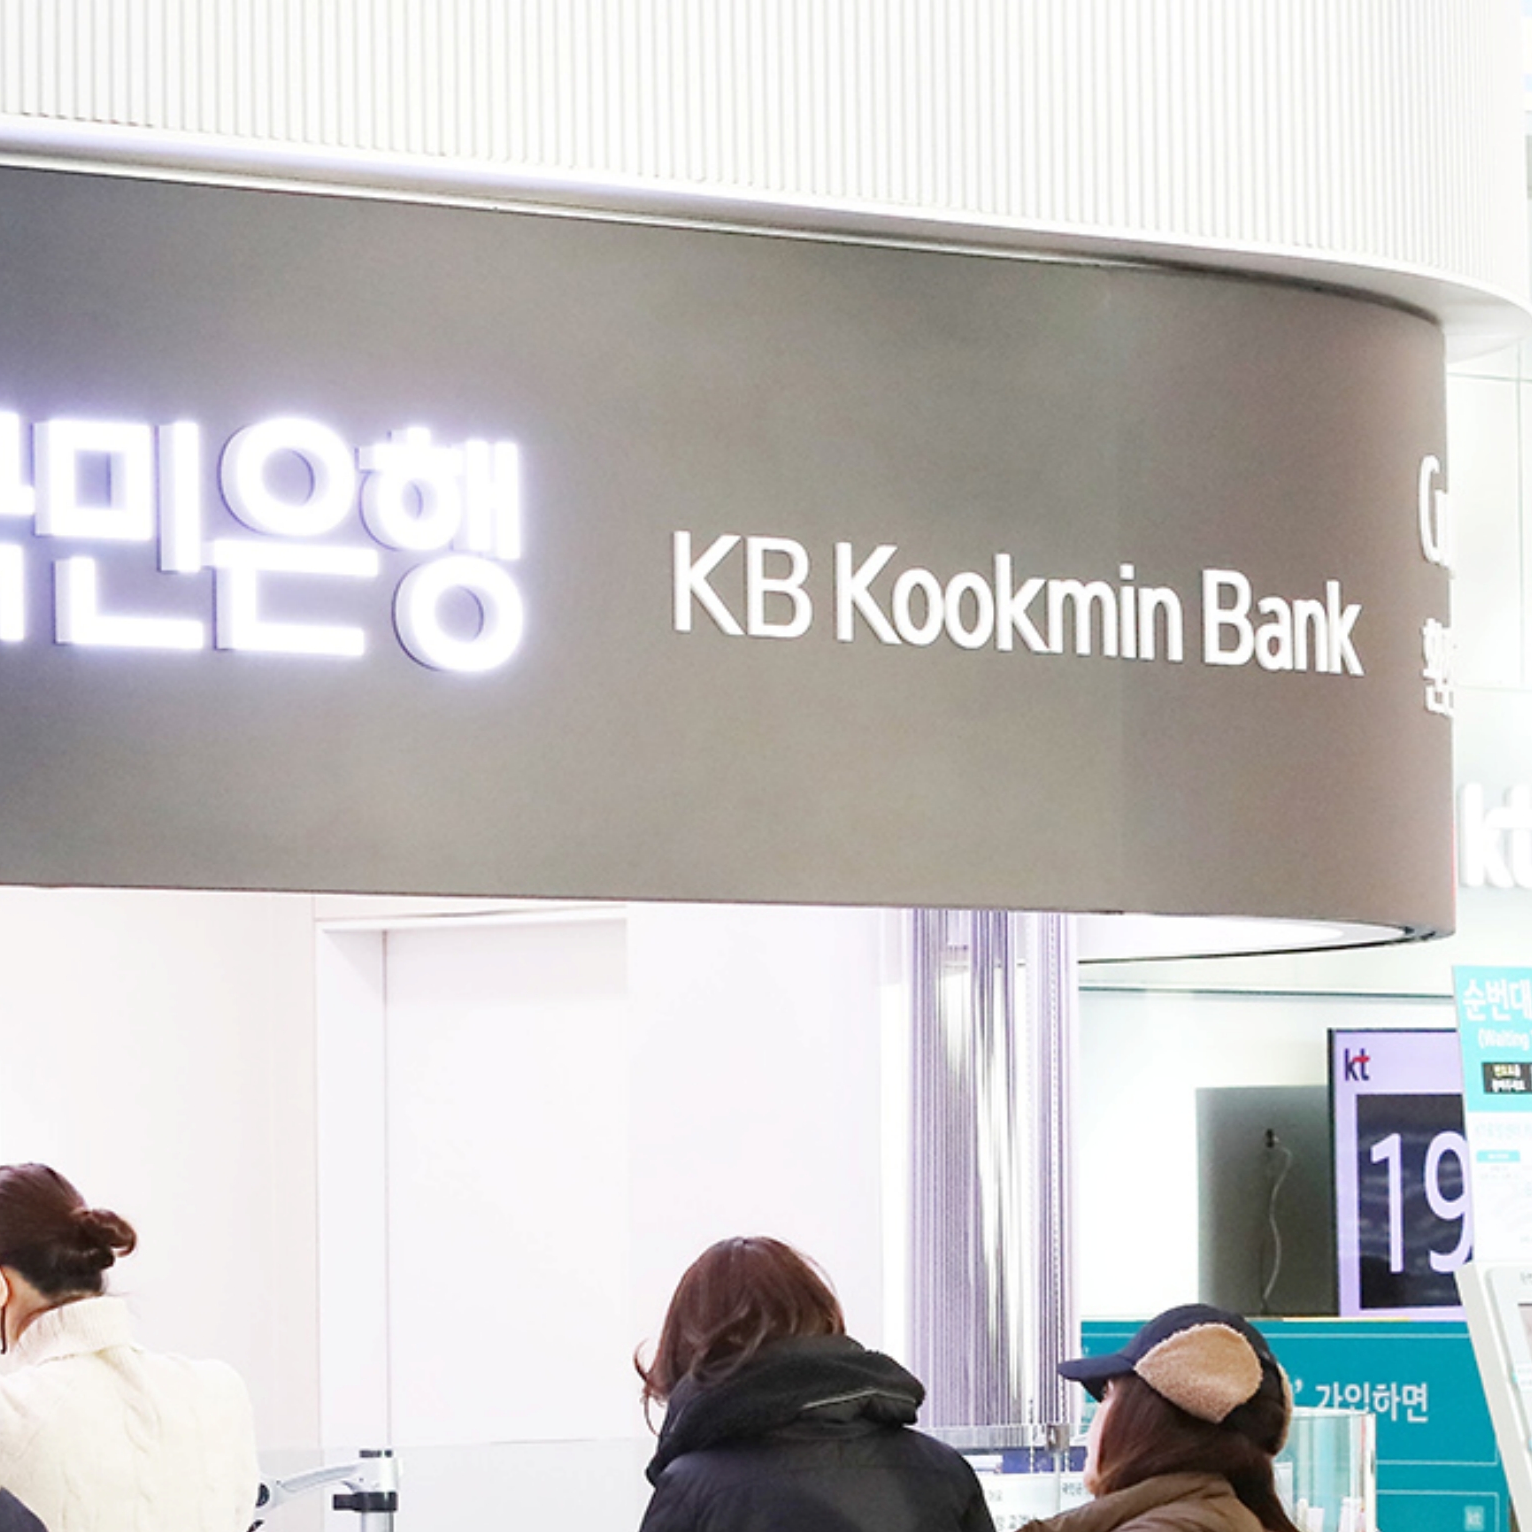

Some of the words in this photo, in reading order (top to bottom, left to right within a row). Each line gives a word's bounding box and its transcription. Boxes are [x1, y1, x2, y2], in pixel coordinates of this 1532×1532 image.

[672, 530, 813, 640] KB
[834, 542, 1184, 663] Kookmin
[1202, 568, 1365, 677] Bank
[1343, 1047, 1371, 1082] kt
